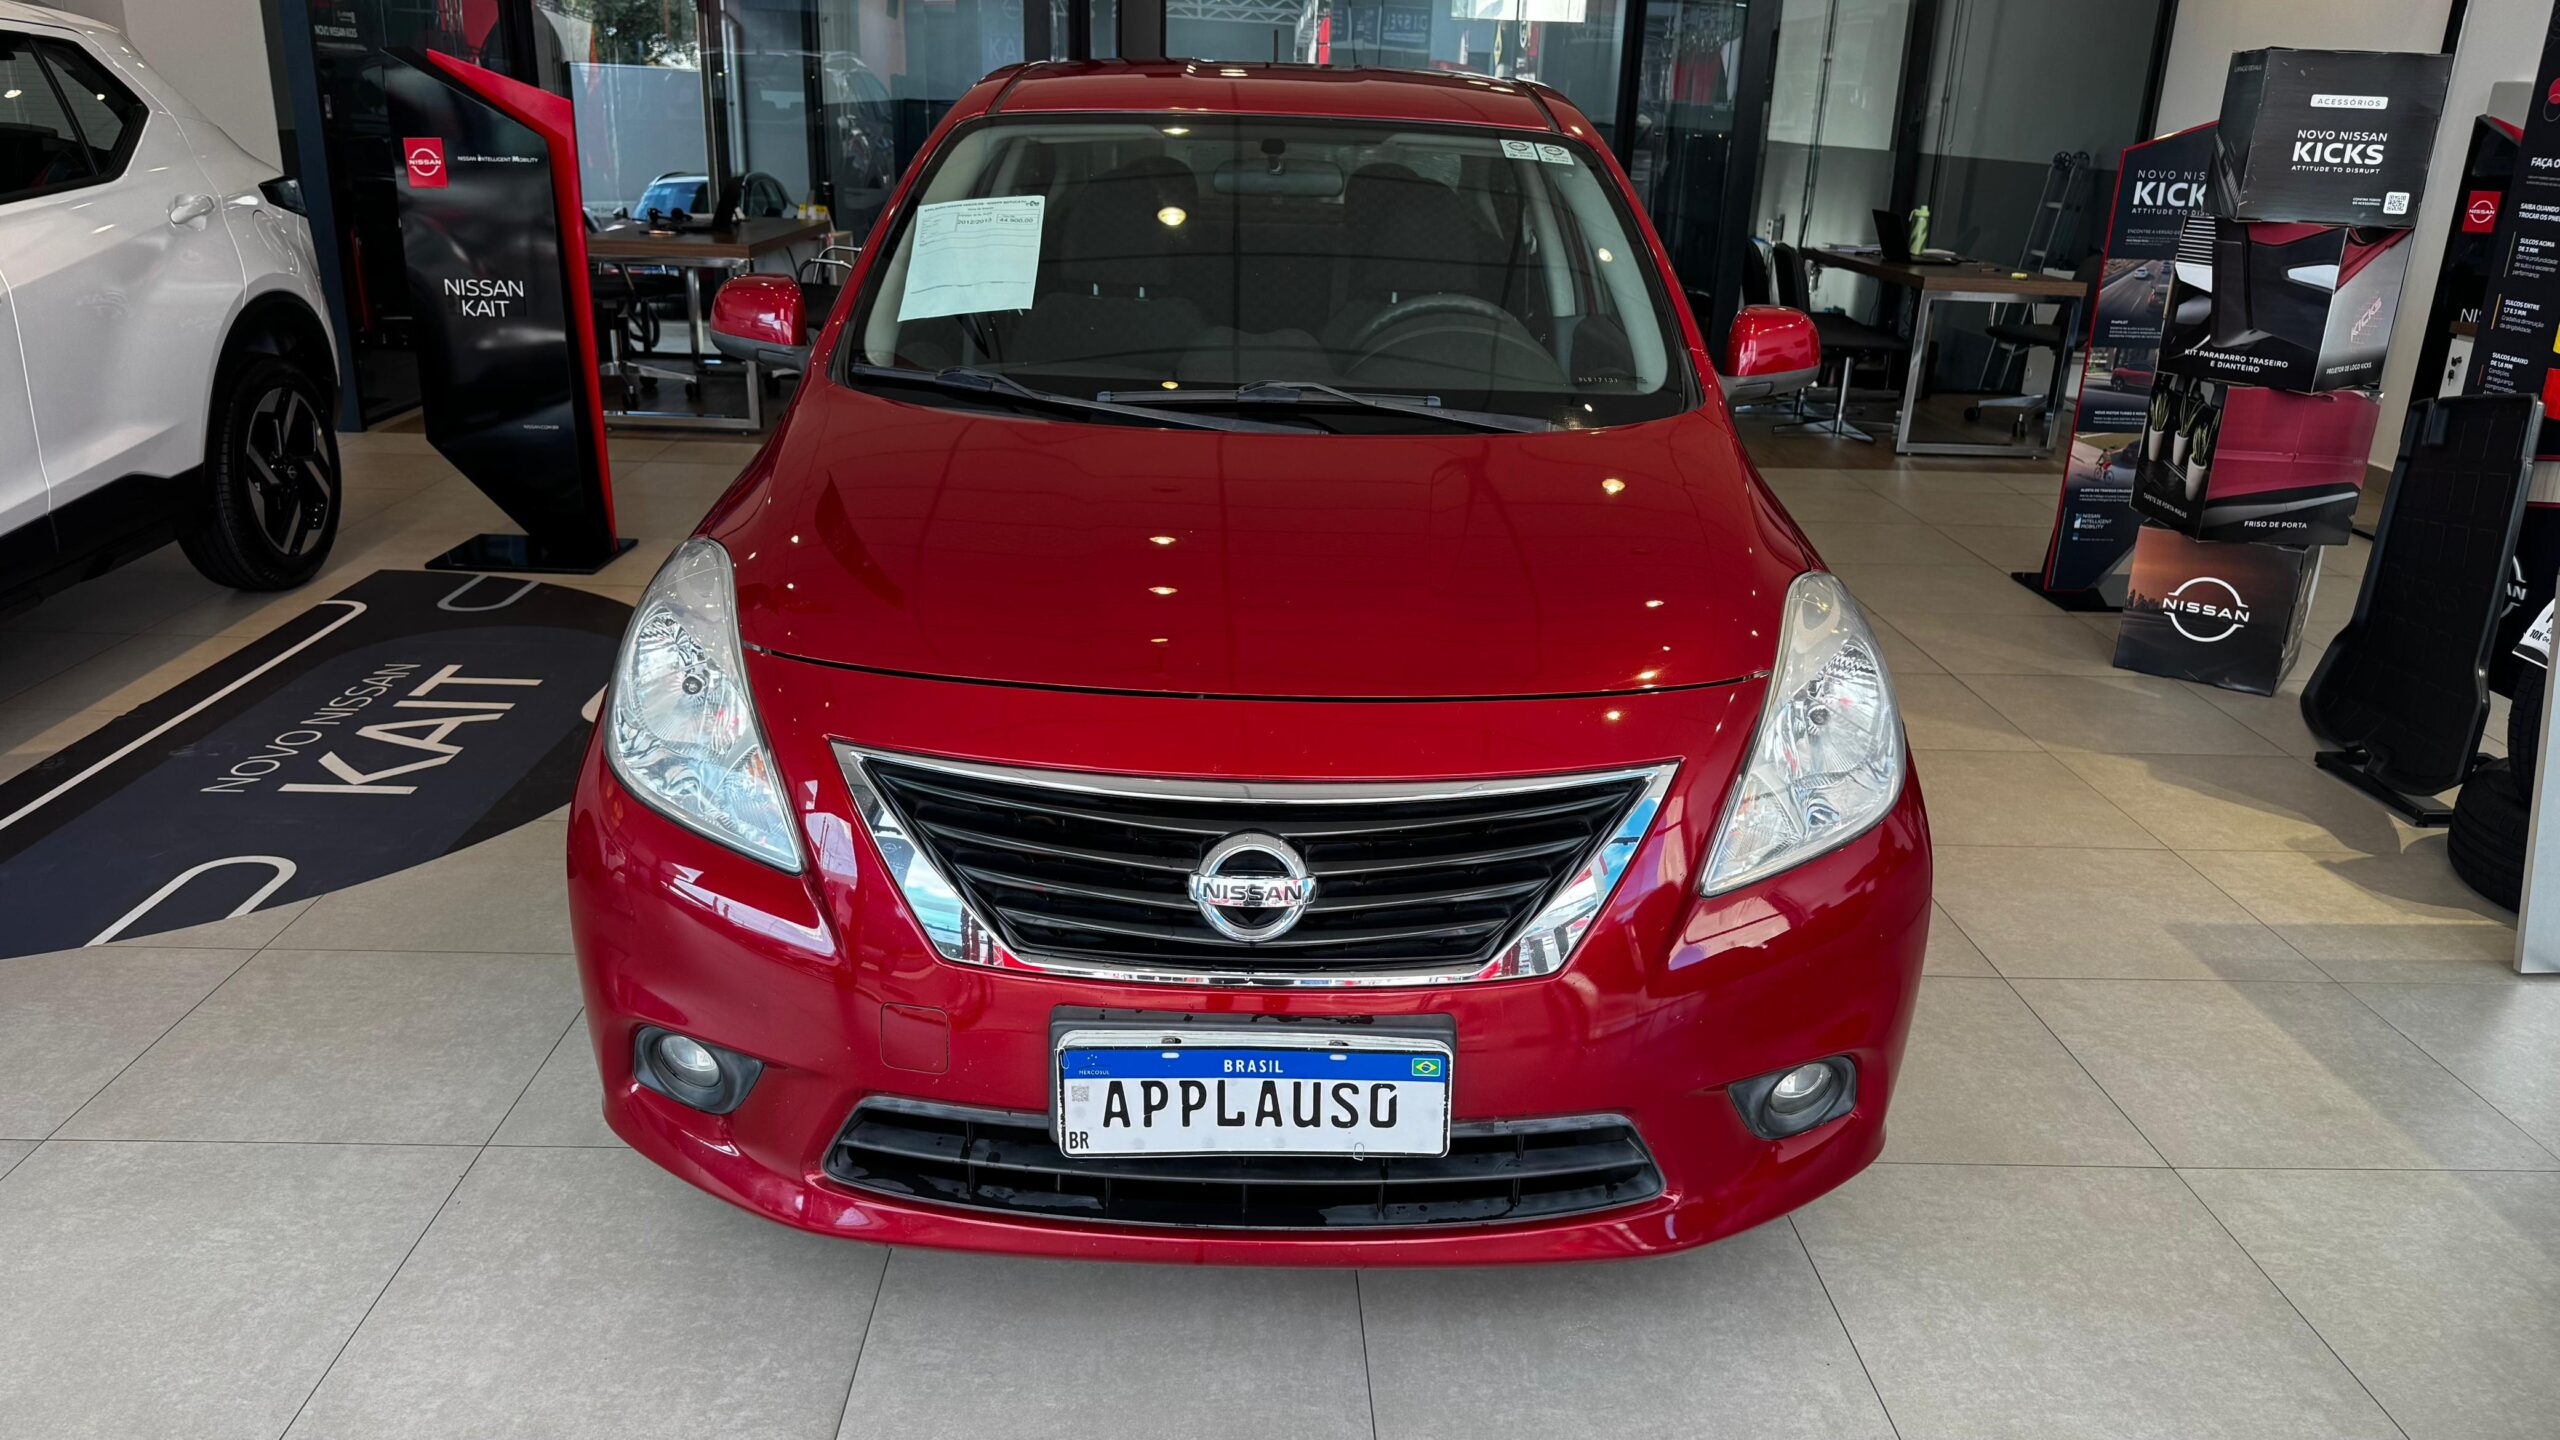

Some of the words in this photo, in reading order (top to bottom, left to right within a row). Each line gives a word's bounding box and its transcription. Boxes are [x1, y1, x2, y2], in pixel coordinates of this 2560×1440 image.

[2316, 97, 2382, 107] ACESSÓRIOS
[2297, 129, 2336, 140] NOVO
[2339, 131, 2388, 142] NISSAN
[2292, 141, 2385, 165] KICKS
[2291, 165, 2330, 173] ATTITUDE
[2530, 157, 2553, 170] FAÇA
[2137, 169, 2176, 180] NOVO
[2184, 170, 2206, 181] NIS
[2133, 181, 2207, 208] KICK
[2131, 207, 2173, 216] ATTITUDE
[2518, 211, 2540, 219] TROCAR
[2520, 237, 2539, 246] SULCOS
[444, 278, 524, 298] NISSAN
[461, 299, 510, 318] KAIT
[2505, 299, 2524, 308] SULCOS
[2184, 348, 2198, 356] KIT
[2199, 350, 2247, 363] PARABARRO
[2249, 356, 2289, 369] TRASEIRO
[2492, 352, 2511, 361] SULCOS
[2217, 361, 2260, 373] DIANTEIRO
[2326, 364, 2345, 375] PROJETOR
[2350, 364, 2361, 372] LOGO
[2244, 520, 2267, 528] FRISO
[2281, 521, 2307, 529] PORTA
[2163, 597, 2250, 622] NISSAN
[2529, 629, 2544, 641] 10X
[200, 729, 323, 793] NOVO
[300, 663, 422, 725] NISSAN
[277, 664, 543, 795] KAIT
[1202, 881, 1302, 903] NISSAN
[1223, 1059, 1284, 1074] BRASIL
[1102, 1079, 1398, 1129] APPLAUSO
[1068, 1131, 1090, 1150] BR
